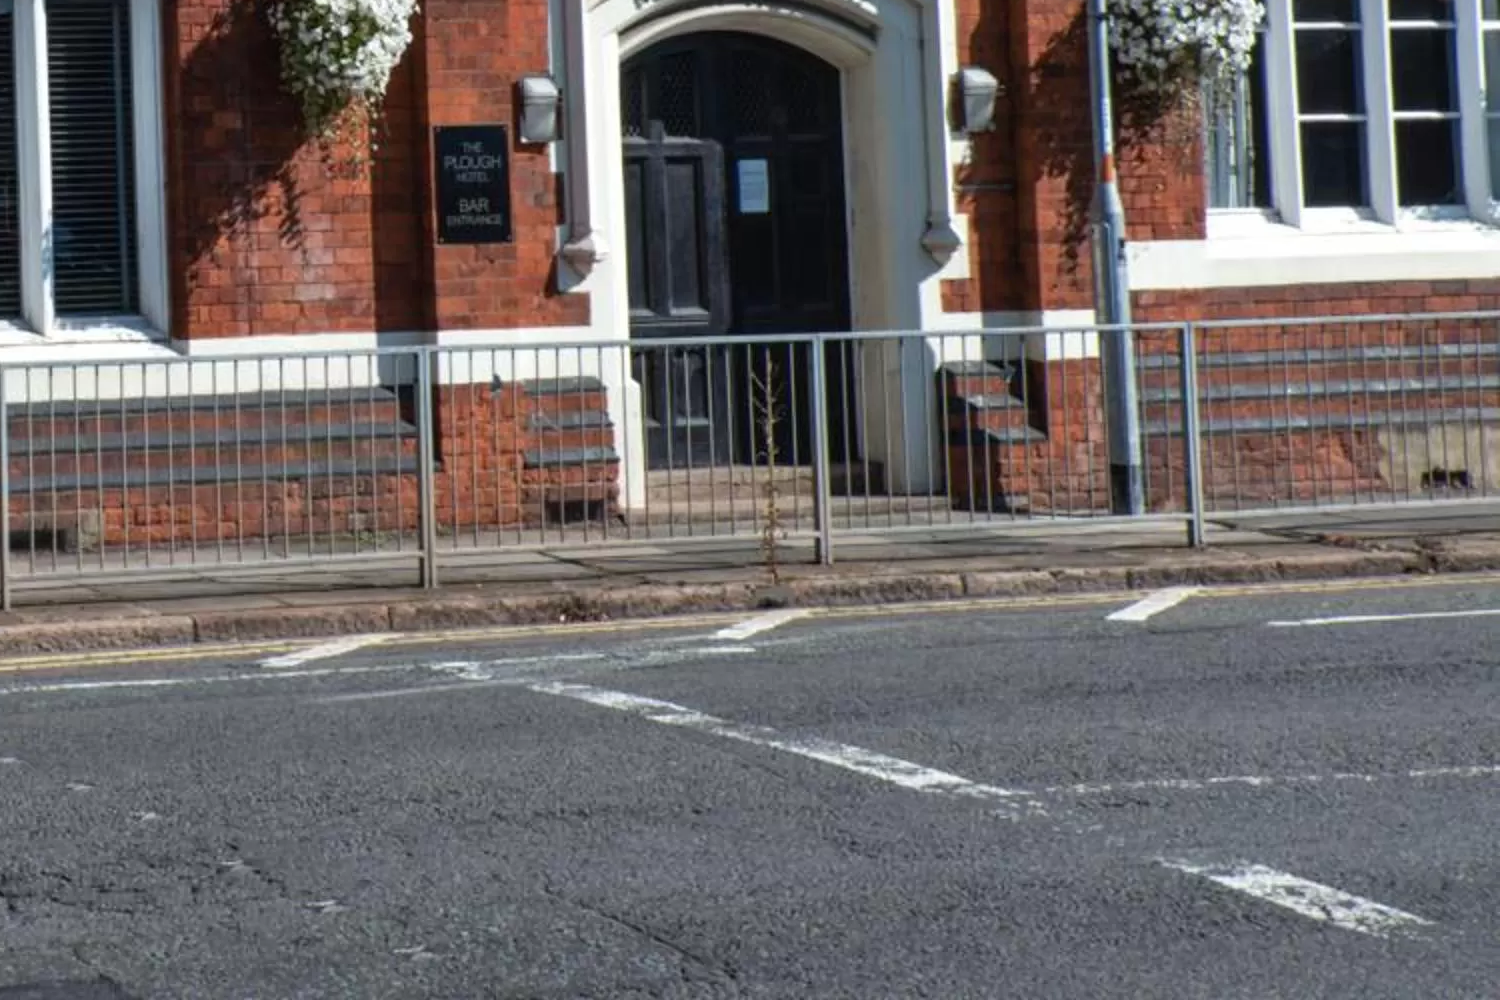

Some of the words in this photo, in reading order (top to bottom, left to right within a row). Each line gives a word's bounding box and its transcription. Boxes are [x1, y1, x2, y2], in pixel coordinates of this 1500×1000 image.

[461, 141, 484, 153] THE
[443, 155, 502, 169] PLOUGH
[458, 198, 490, 213] BAR
[445, 214, 504, 227] ENTRANCE
